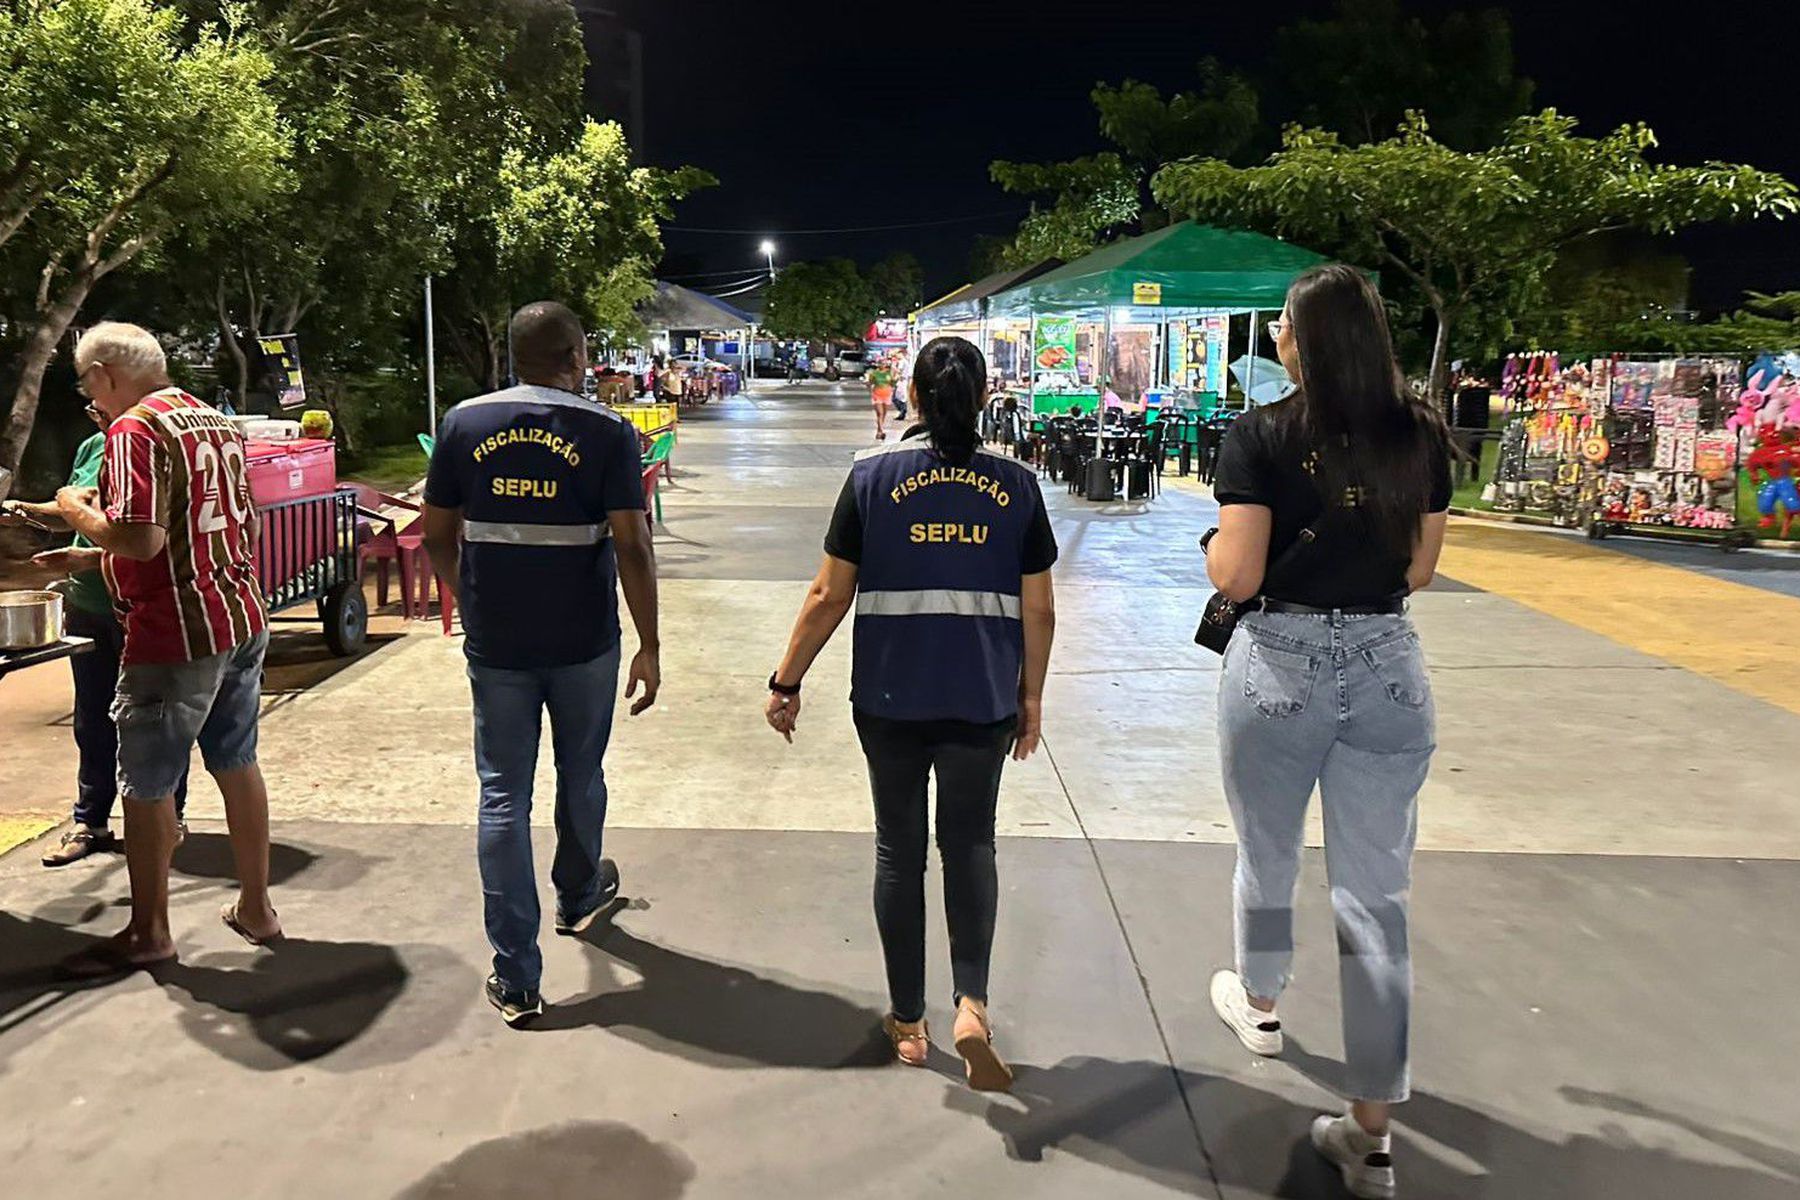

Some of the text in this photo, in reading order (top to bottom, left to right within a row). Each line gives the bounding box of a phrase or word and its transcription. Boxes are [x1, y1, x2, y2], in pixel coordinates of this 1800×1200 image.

[167, 410, 236, 431] Unime
[473, 428, 580, 467] FISCALIZAÇÃO
[195, 441, 247, 534] 20
[492, 477, 557, 498] SEPLU
[890, 467, 1010, 507] FISCALIZAÇÃO
[910, 523, 989, 544] SEPLU
